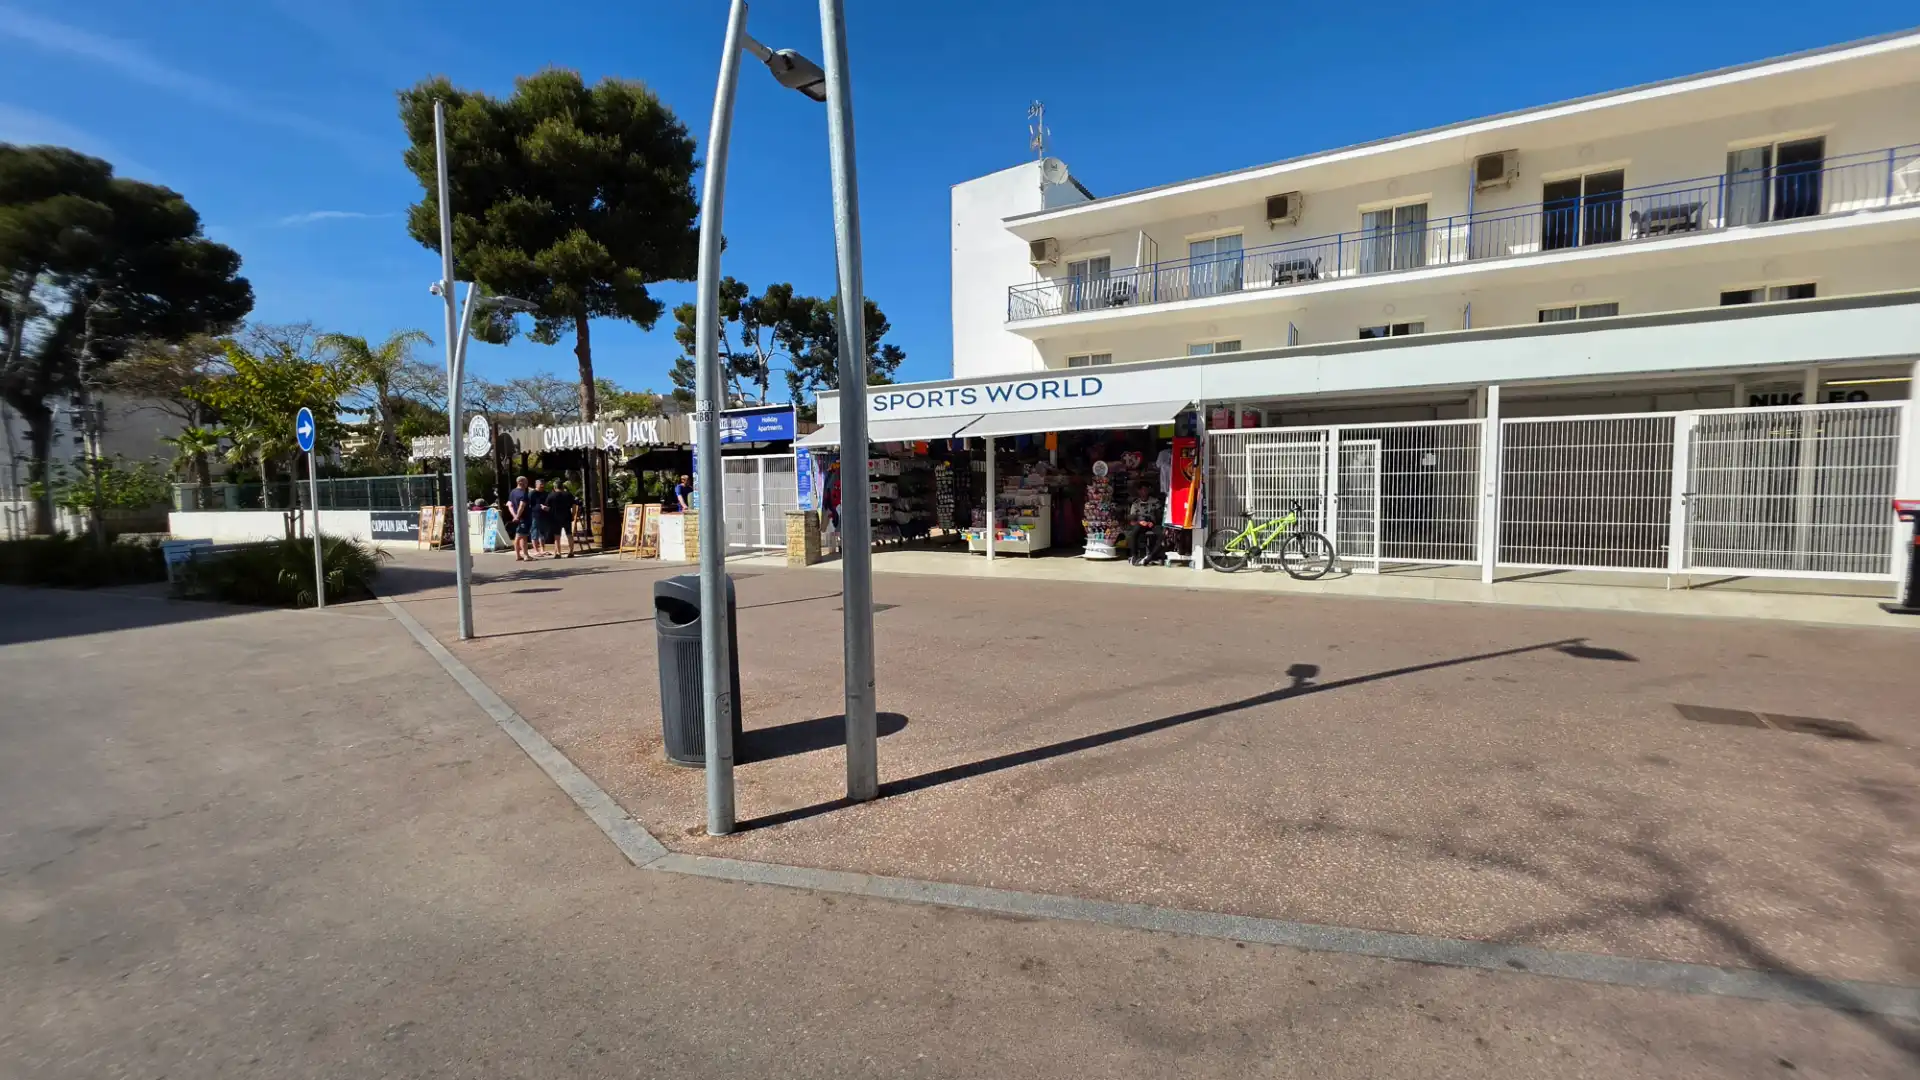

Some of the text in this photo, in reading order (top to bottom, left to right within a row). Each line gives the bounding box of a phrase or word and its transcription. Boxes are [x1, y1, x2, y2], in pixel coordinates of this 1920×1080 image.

[873, 376, 1103, 412] SPORTS WORLD
[1750, 389, 1869, 407] NUCEO
[761, 416, 778, 424] Holiday
[473, 427, 486, 438] JACK
[543, 419, 661, 450] CAPTAIN JACK
[757, 424, 783, 432] Apartments
[371, 519, 395, 532] CAPTAIN
[396, 519, 409, 532] JACK
